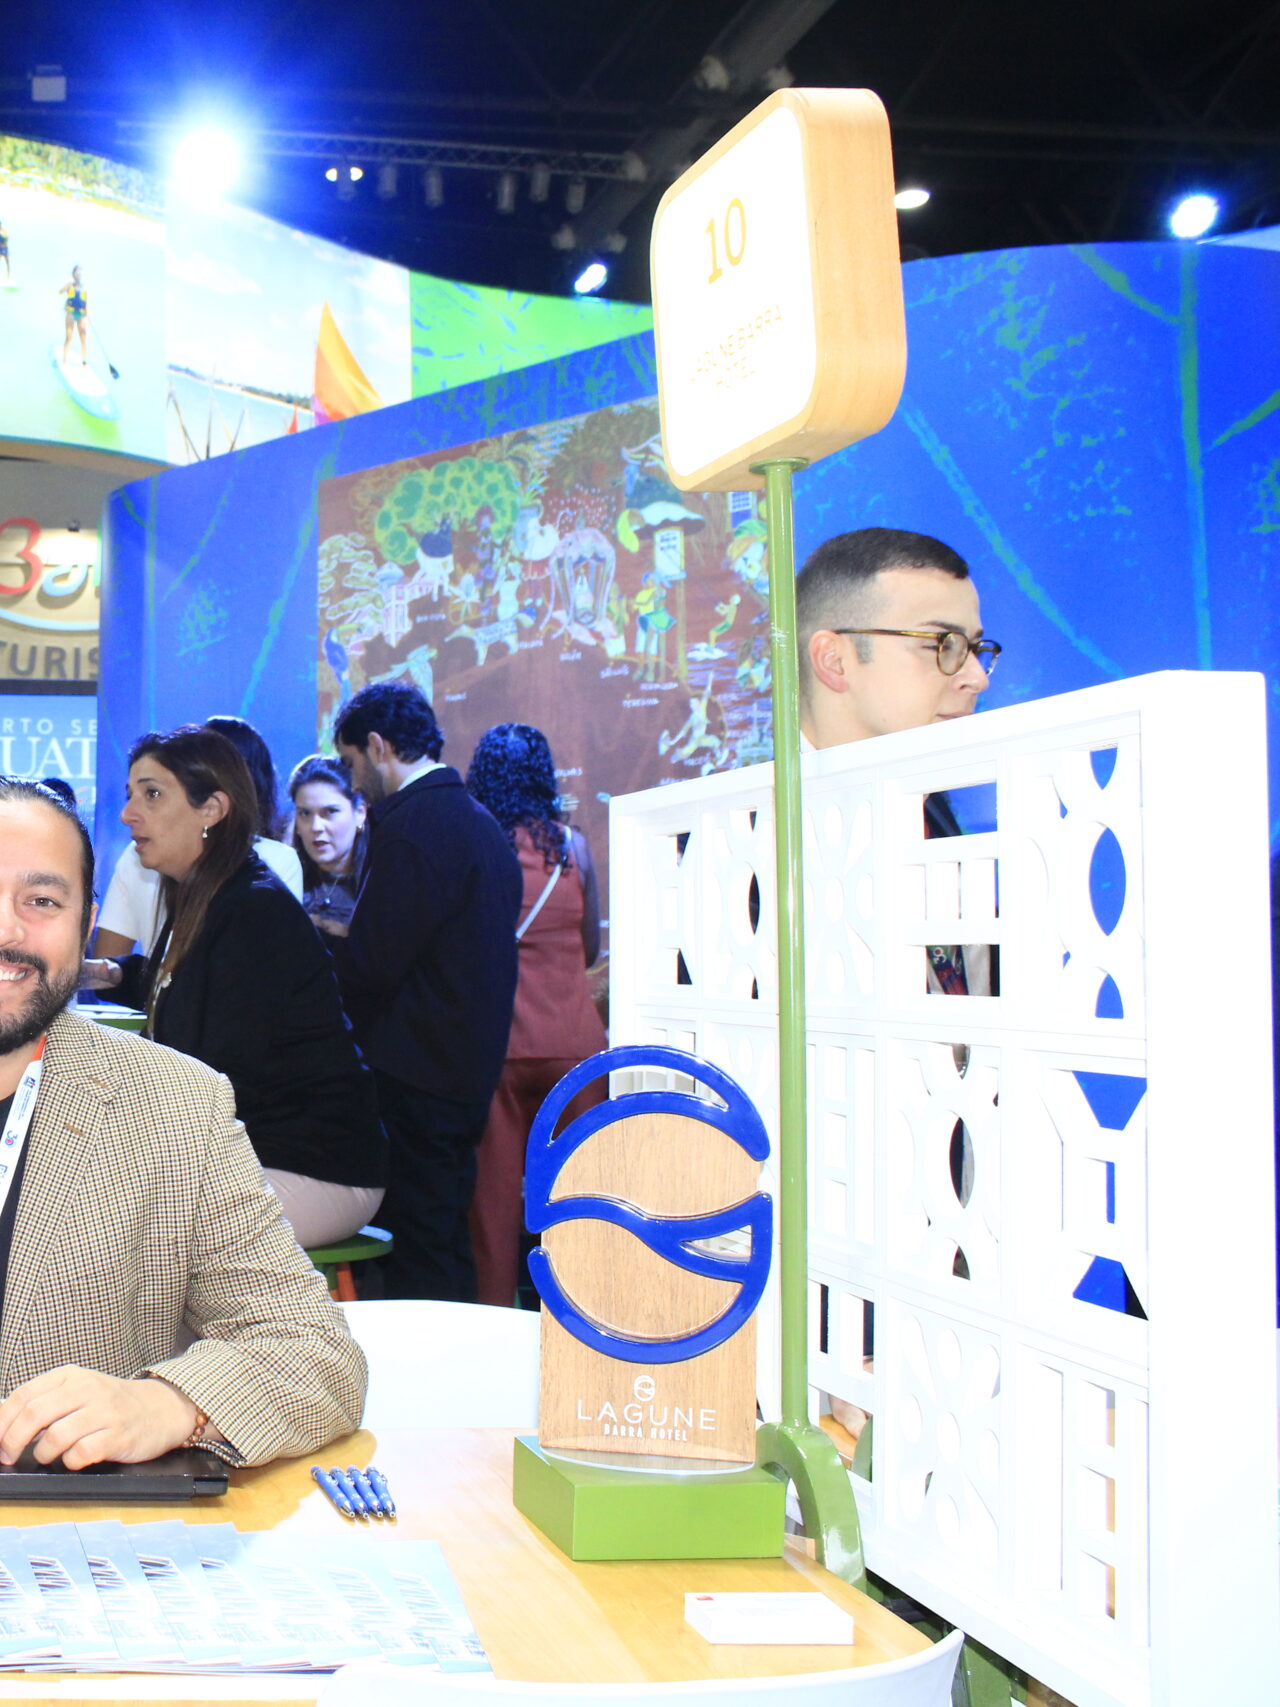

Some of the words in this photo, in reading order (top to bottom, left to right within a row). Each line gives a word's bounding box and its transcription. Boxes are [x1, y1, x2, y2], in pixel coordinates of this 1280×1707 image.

[706, 197, 747, 285] 10
[737, 304, 783, 350] BARRA
[577, 1399, 717, 1431] LAGUNE
[603, 1423, 643, 1438] BARRA
[650, 1427, 688, 1442] HOTEL
